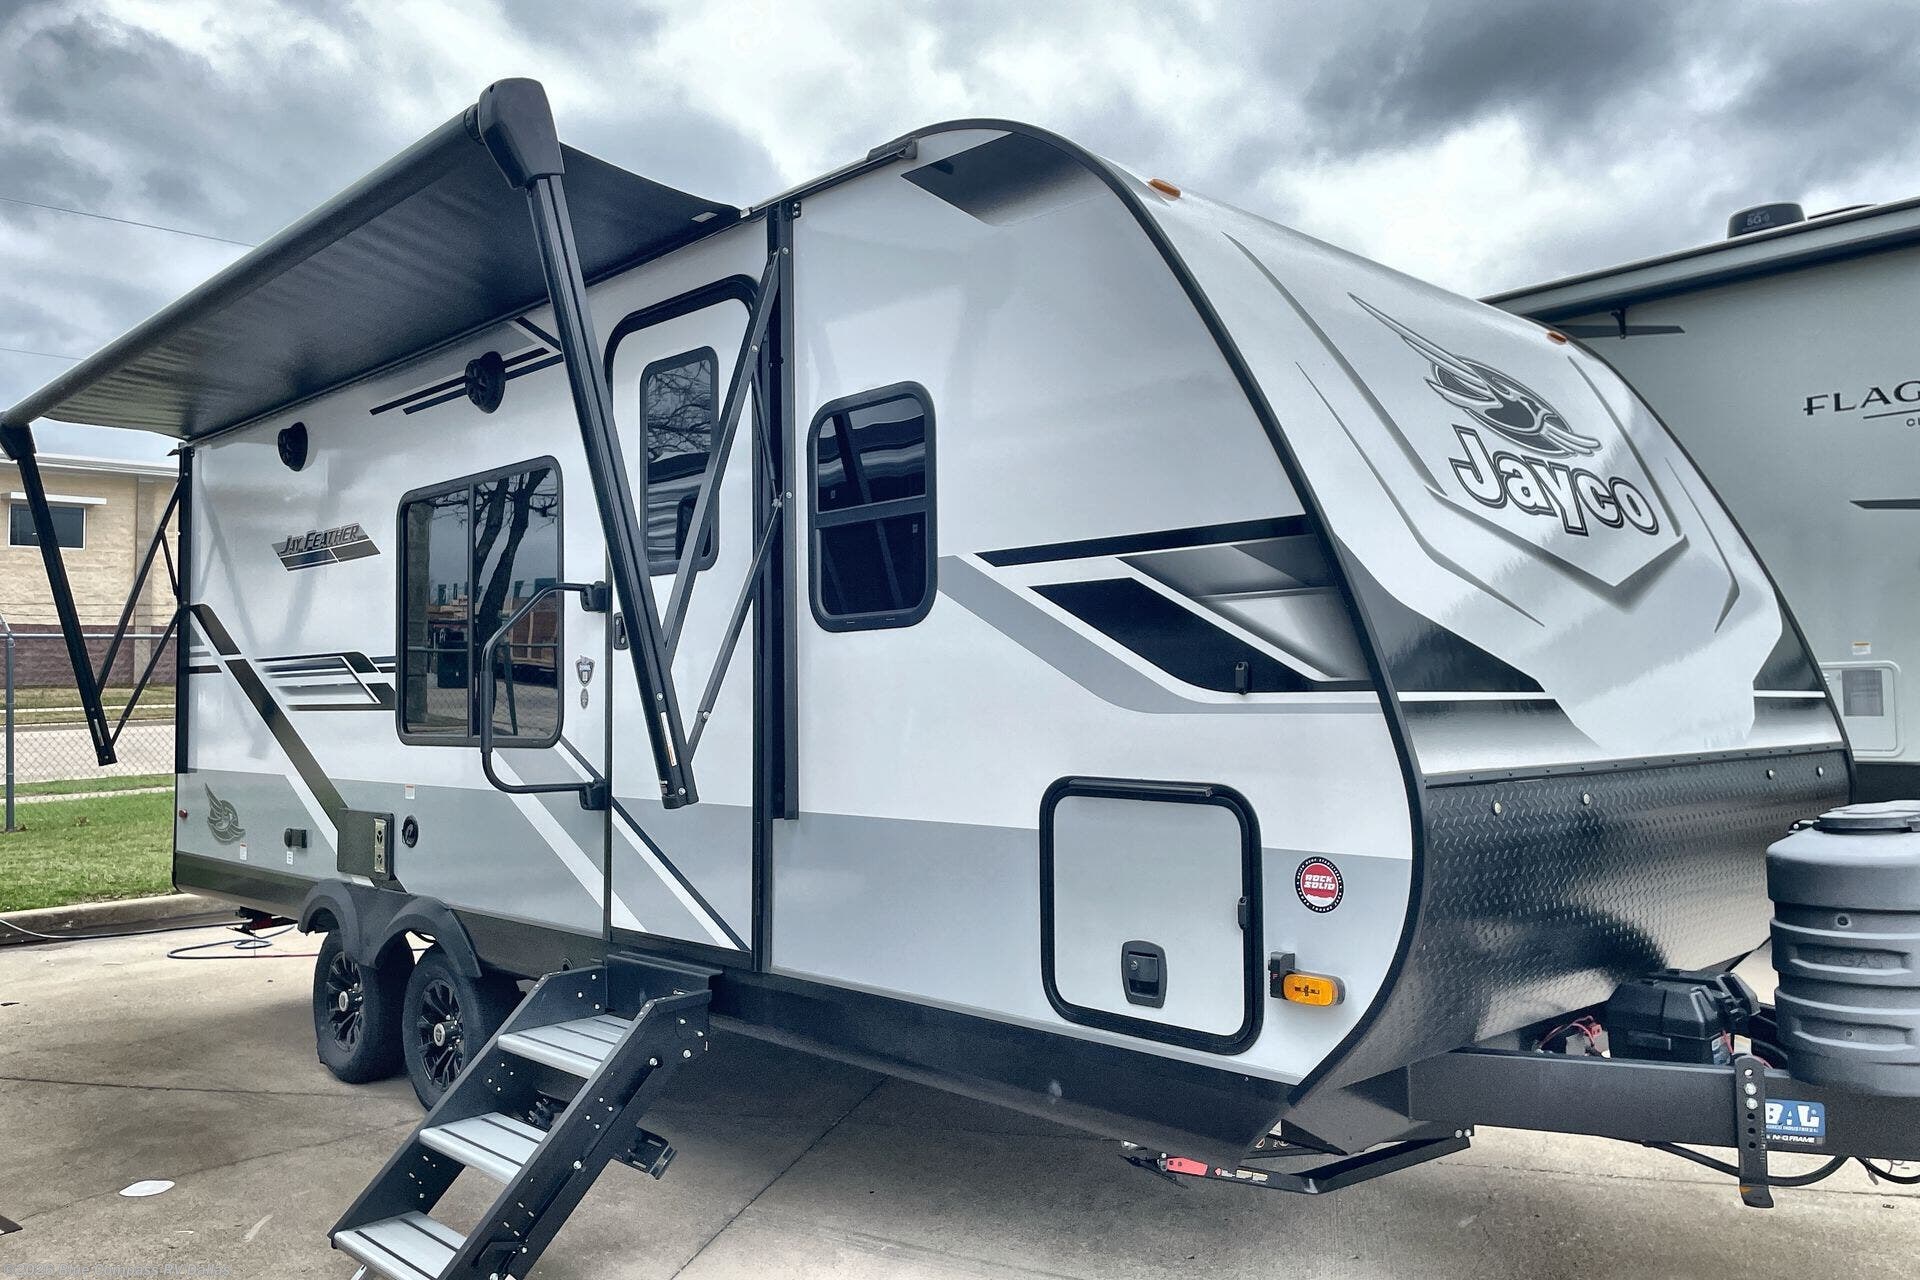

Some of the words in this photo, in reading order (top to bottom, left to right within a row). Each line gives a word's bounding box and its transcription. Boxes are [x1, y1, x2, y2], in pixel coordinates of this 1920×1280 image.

[1448, 424, 1659, 536] Jayco
[279, 536, 303, 556] JAY
[304, 523, 360, 552] FEATHER
[1304, 881, 1336, 891] SOLID
[1305, 874, 1333, 883] ROCK
[1765, 1103, 1819, 1128] BAL
